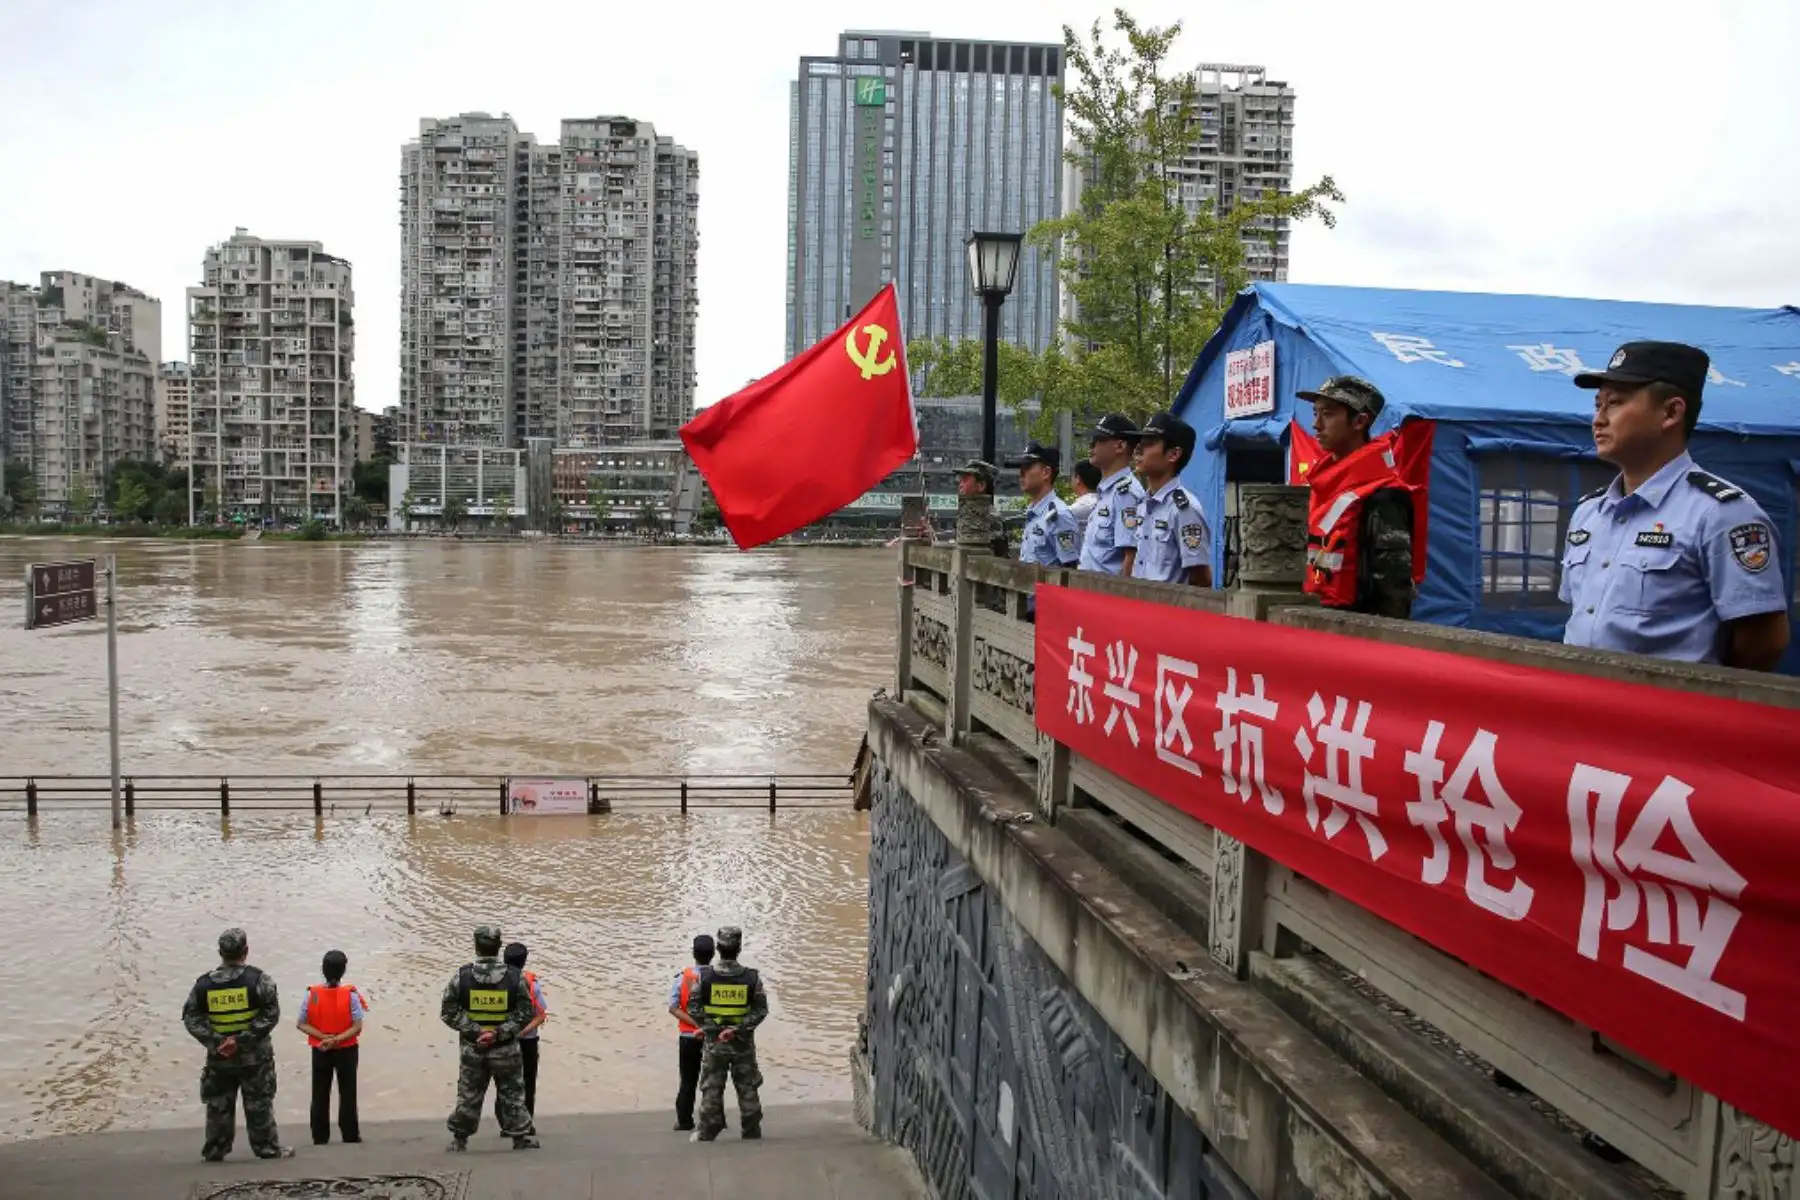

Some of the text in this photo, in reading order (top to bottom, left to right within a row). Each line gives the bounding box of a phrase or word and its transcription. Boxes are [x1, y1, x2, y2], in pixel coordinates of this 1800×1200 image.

[1066, 626, 1748, 1022] 东兴区抗洪抢险
